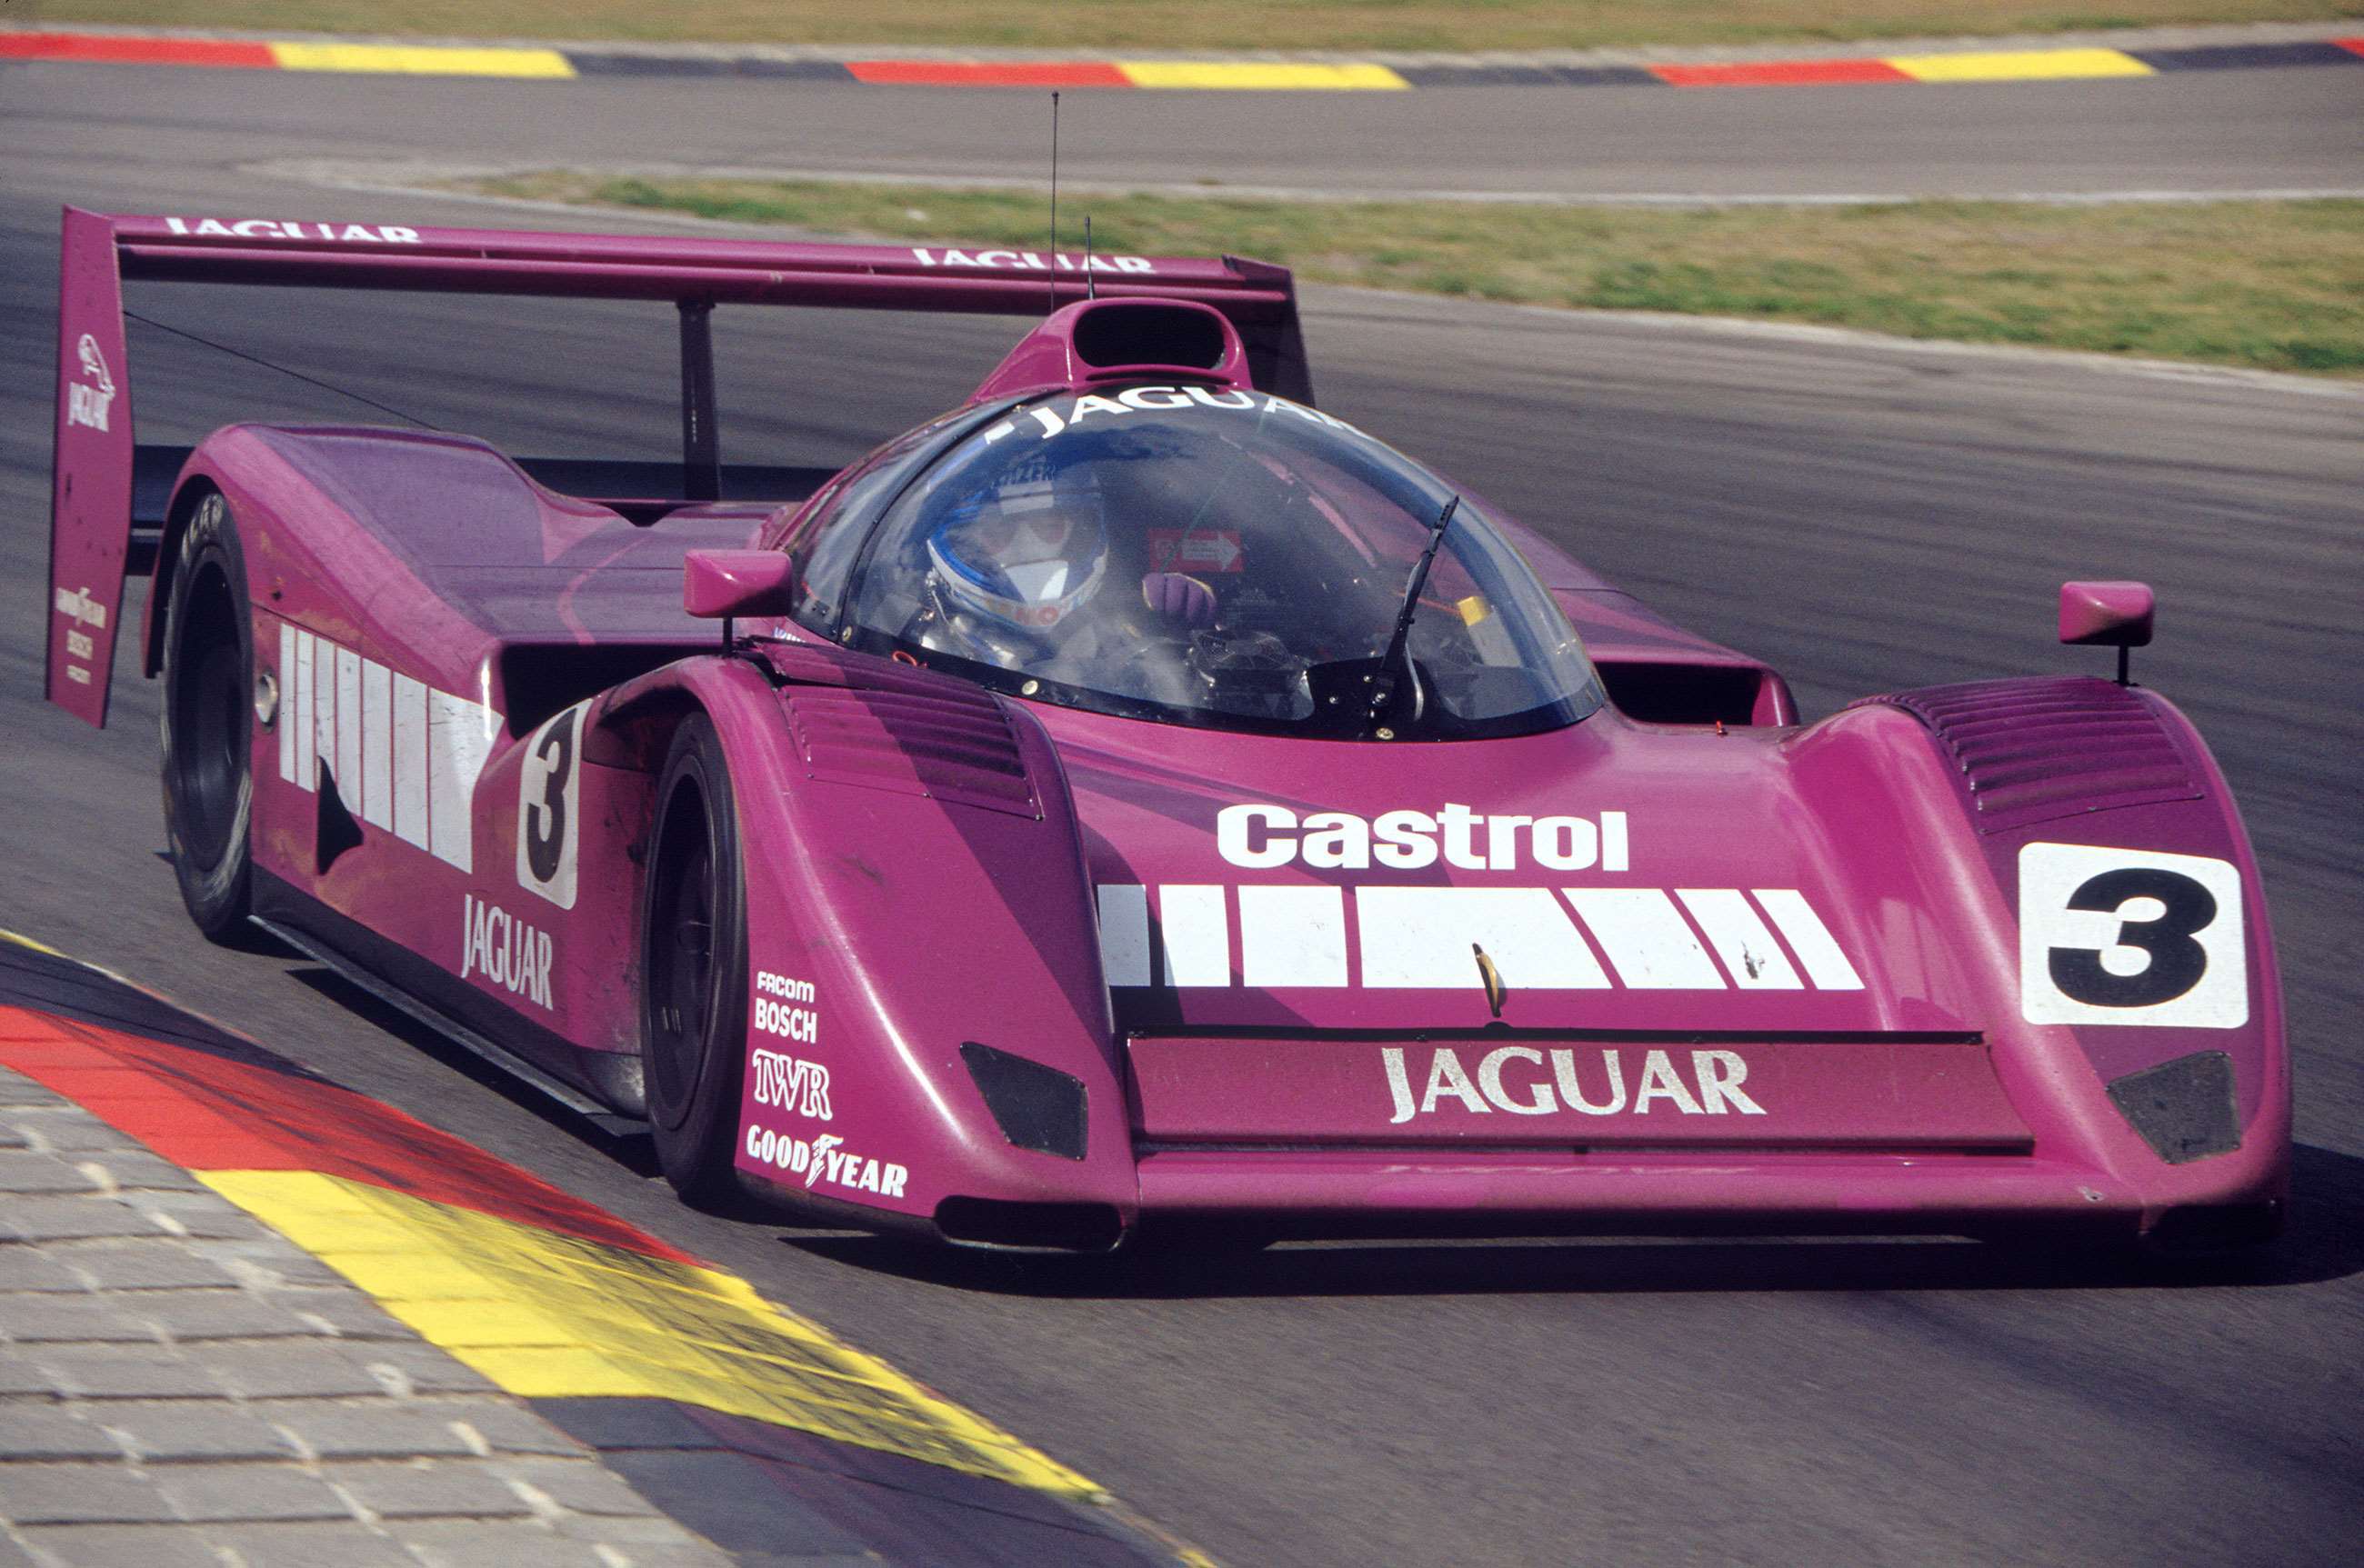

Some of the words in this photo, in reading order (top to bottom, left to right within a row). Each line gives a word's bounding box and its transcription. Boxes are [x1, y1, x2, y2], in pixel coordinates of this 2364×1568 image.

[526, 707, 577, 884] 3
[1217, 803, 1629, 872] Castrol
[460, 894, 554, 1011] JAGUAR
[2048, 868, 2217, 1008] 3
[755, 997, 817, 1044] BOSCH
[752, 1048, 833, 1121] TWR
[1381, 1046, 1768, 1124] JAGUAR
